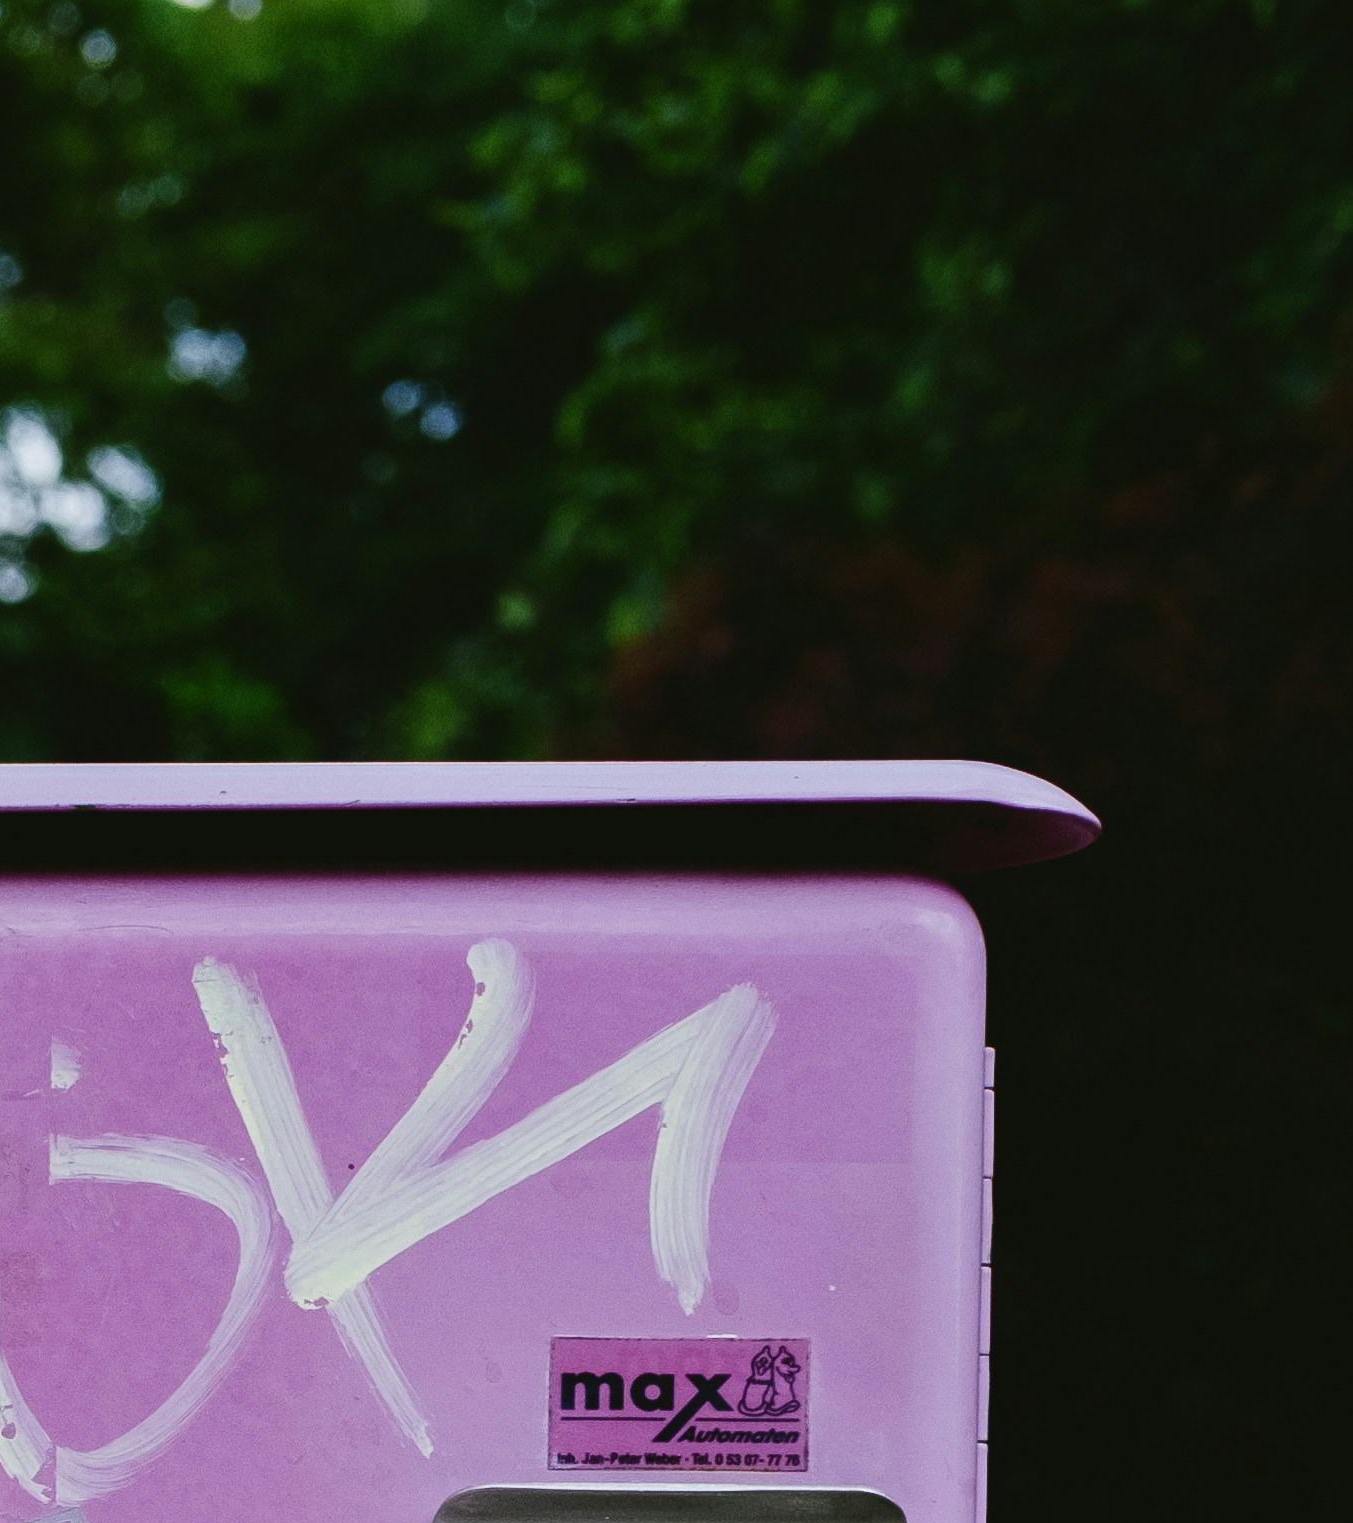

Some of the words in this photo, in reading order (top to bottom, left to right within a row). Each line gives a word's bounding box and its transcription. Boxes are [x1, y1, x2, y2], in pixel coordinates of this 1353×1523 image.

[560, 1371, 734, 1442] max
[677, 1425, 800, 1443] Automaten
[692, 1453, 713, 1465] Tel.
[715, 1453, 724, 1465] 0
